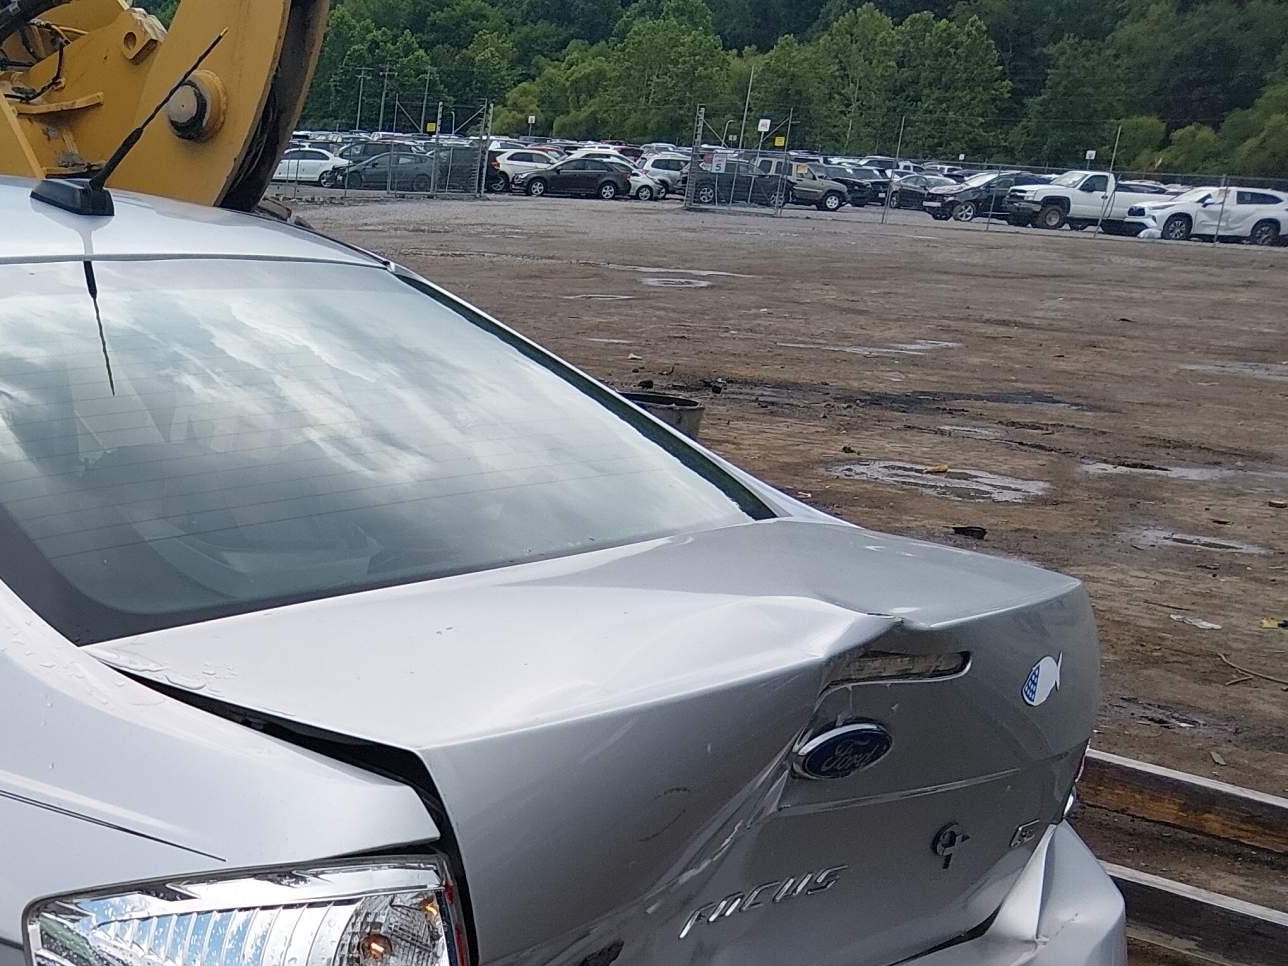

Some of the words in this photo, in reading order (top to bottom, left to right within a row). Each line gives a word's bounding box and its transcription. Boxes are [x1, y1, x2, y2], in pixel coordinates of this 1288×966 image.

[715, 163, 722, 171] 5
[820, 738, 881, 772] Ford
[679, 864, 849, 940] FOCUS
